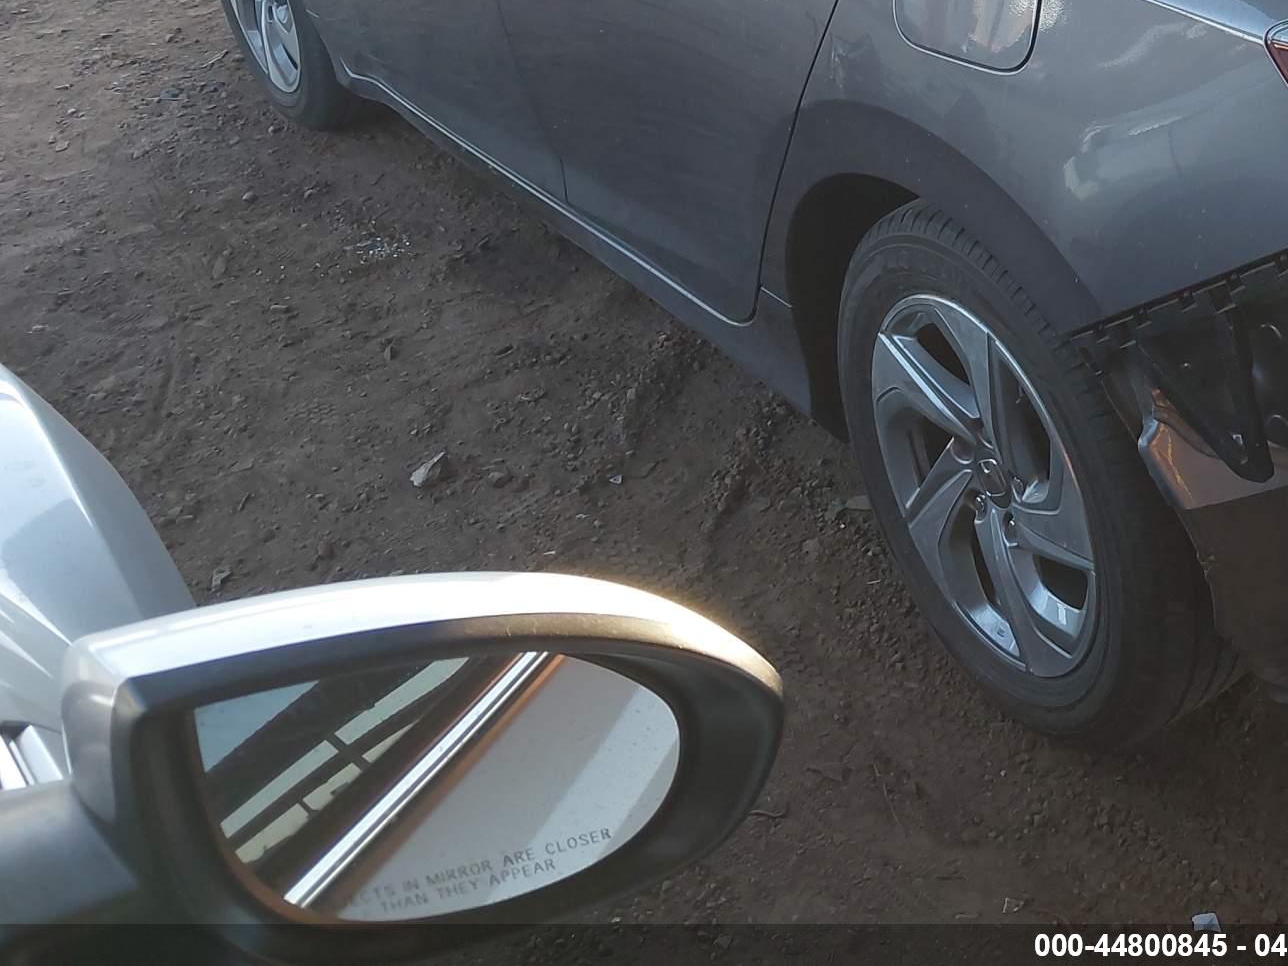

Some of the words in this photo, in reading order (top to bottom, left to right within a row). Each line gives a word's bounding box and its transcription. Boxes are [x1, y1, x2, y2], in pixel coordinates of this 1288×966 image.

[380, 893, 429, 913] THAN
[438, 879, 480, 900] THEY
[488, 859, 557, 887] APPEAR
[405, 878, 420, 893] IN
[425, 859, 493, 885] MIRROR
[502, 848, 536, 868] ARE
[544, 827, 613, 856] CLOSER
